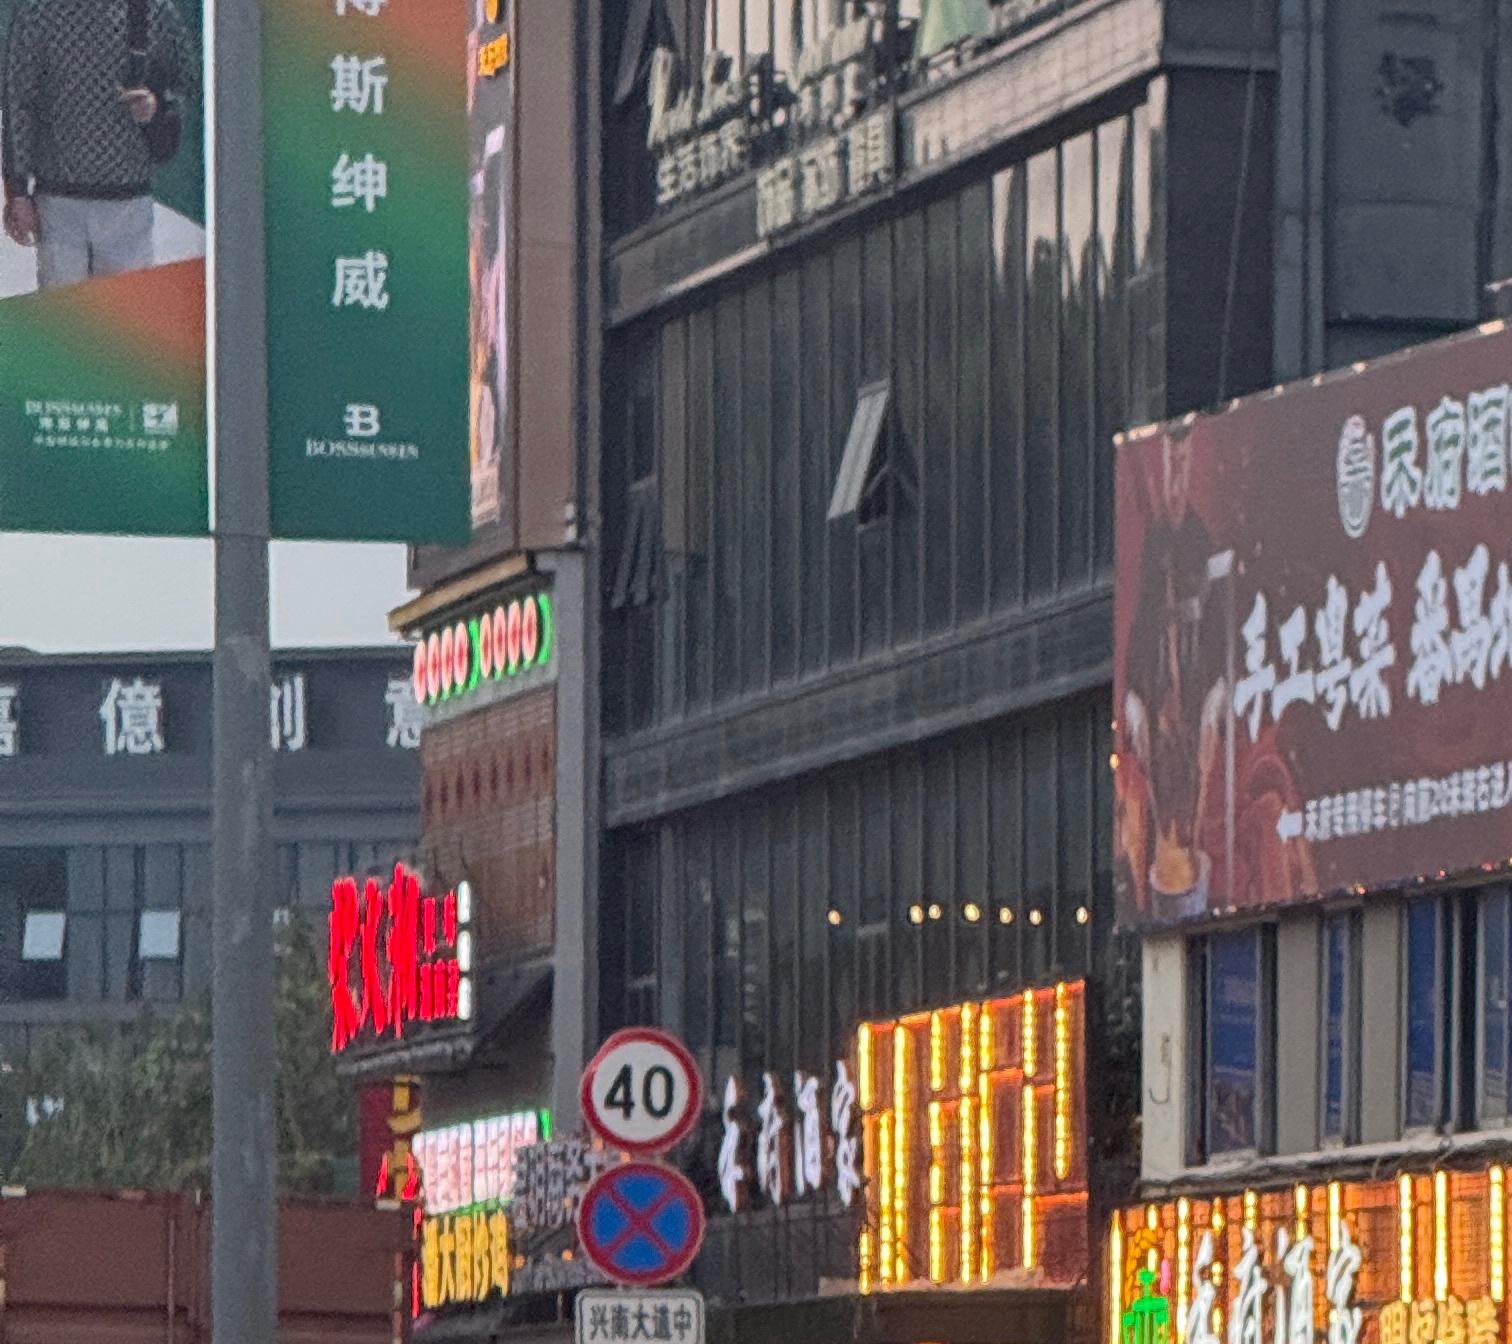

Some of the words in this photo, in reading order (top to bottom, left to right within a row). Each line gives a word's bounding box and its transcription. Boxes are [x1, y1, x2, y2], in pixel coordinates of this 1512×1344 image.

[329, 0, 390, 311] 斯绅威
[1232, 561, 1396, 741] 手工粤菜
[604, 1063, 675, 1120] 40
[590, 1302, 692, 1342] 兴南大道中
